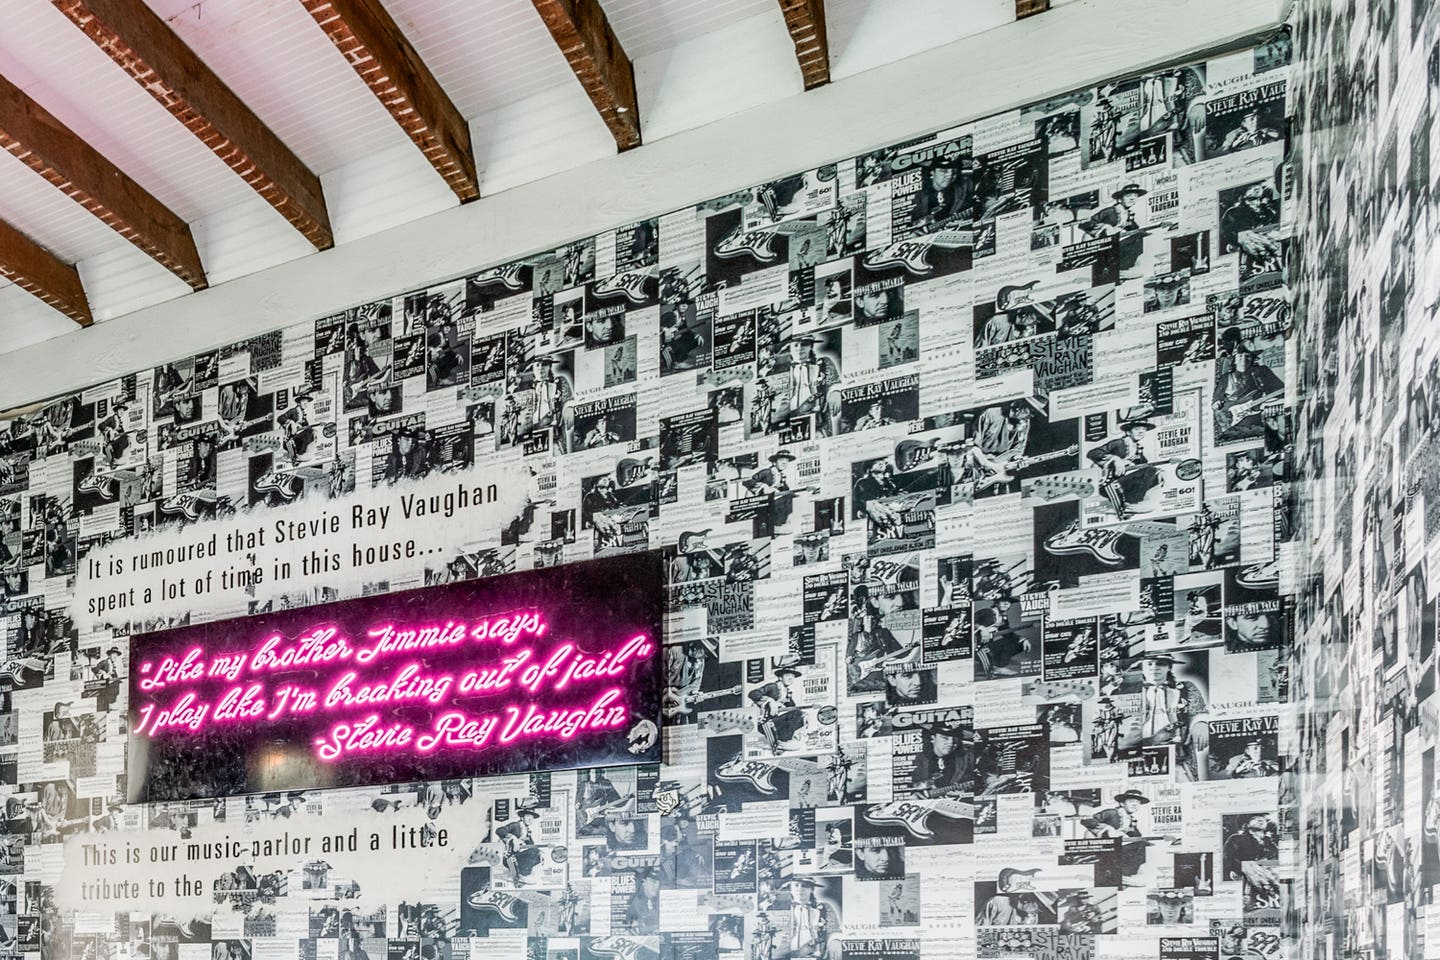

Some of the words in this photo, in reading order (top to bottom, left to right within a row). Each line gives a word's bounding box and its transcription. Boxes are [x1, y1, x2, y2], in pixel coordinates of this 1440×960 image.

[1206, 98, 1238, 115] STEVIE
[1240, 90, 1261, 106] RAY
[891, 137, 973, 171] GUITAR
[892, 172, 923, 189] BLUES
[892, 181, 923, 198] POWER!
[1034, 333, 1087, 359] STEVIE
[1033, 350, 1088, 379] VAUGHAN
[1054, 349, 1080, 365] RAY
[841, 385, 866, 400] STEVIE
[867, 381, 885, 396] RAY
[1157, 429, 1178, 441] STEVIE
[1180, 427, 1192, 436] RAY
[1160, 436, 1189, 449] VAUGHAN
[89, 557, 101, 580] It
[110, 553, 123, 576] is
[132, 533, 217, 572] rumoured
[226, 527, 265, 553] that
[275, 510, 340, 544] Stevie
[351, 504, 391, 530] Ray
[400, 483, 498, 518] Vaughan
[876, 525, 906, 540] SRV
[88, 587, 135, 618] spent
[143, 587, 152, 604] a
[161, 578, 186, 601] lot
[195, 570, 212, 594] of
[221, 566, 264, 591] time
[274, 557, 291, 581] in
[302, 547, 341, 576] this
[352, 538, 443, 568] house...
[707, 581, 748, 595] STEVIE
[708, 598, 750, 617] VAUGHAN
[722, 594, 744, 605] RAY
[208, 653, 248, 680] my
[250, 626, 353, 671] brother
[356, 621, 466, 664] Jimmie
[471, 613, 546, 644] says,
[133, 704, 154, 734] I
[148, 693, 211, 736] play
[213, 684, 265, 721] like
[268, 686, 316, 719] I'm
[325, 664, 453, 708] breaking
[459, 649, 532, 692] out
[520, 644, 574, 693] of
[555, 634, 653, 690] jail"
[416, 711, 498, 751] Ray
[499, 688, 626, 743] Vaughn
[891, 708, 974, 728] GUITAR
[1209, 722, 1241, 735] STEVIE
[1242, 719, 1263, 732] RAY
[893, 732, 923, 746] BLUES
[81, 842, 117, 866] This
[126, 841, 140, 864] is
[150, 844, 178, 863] our
[187, 835, 241, 861] music
[251, 831, 312, 862] parlor
[322, 827, 358, 853] and
[369, 832, 380, 851] a
[81, 878, 140, 901] tribute
[149, 878, 165, 898] to
[174, 873, 203, 898] the
[841, 941, 866, 951] STEVIE
[867, 940, 884, 950] RAY
[884, 940, 920, 950] VAUGHAN
[1036, 930, 1089, 948] STEVIE
[1056, 946, 1082, 960] RAY
